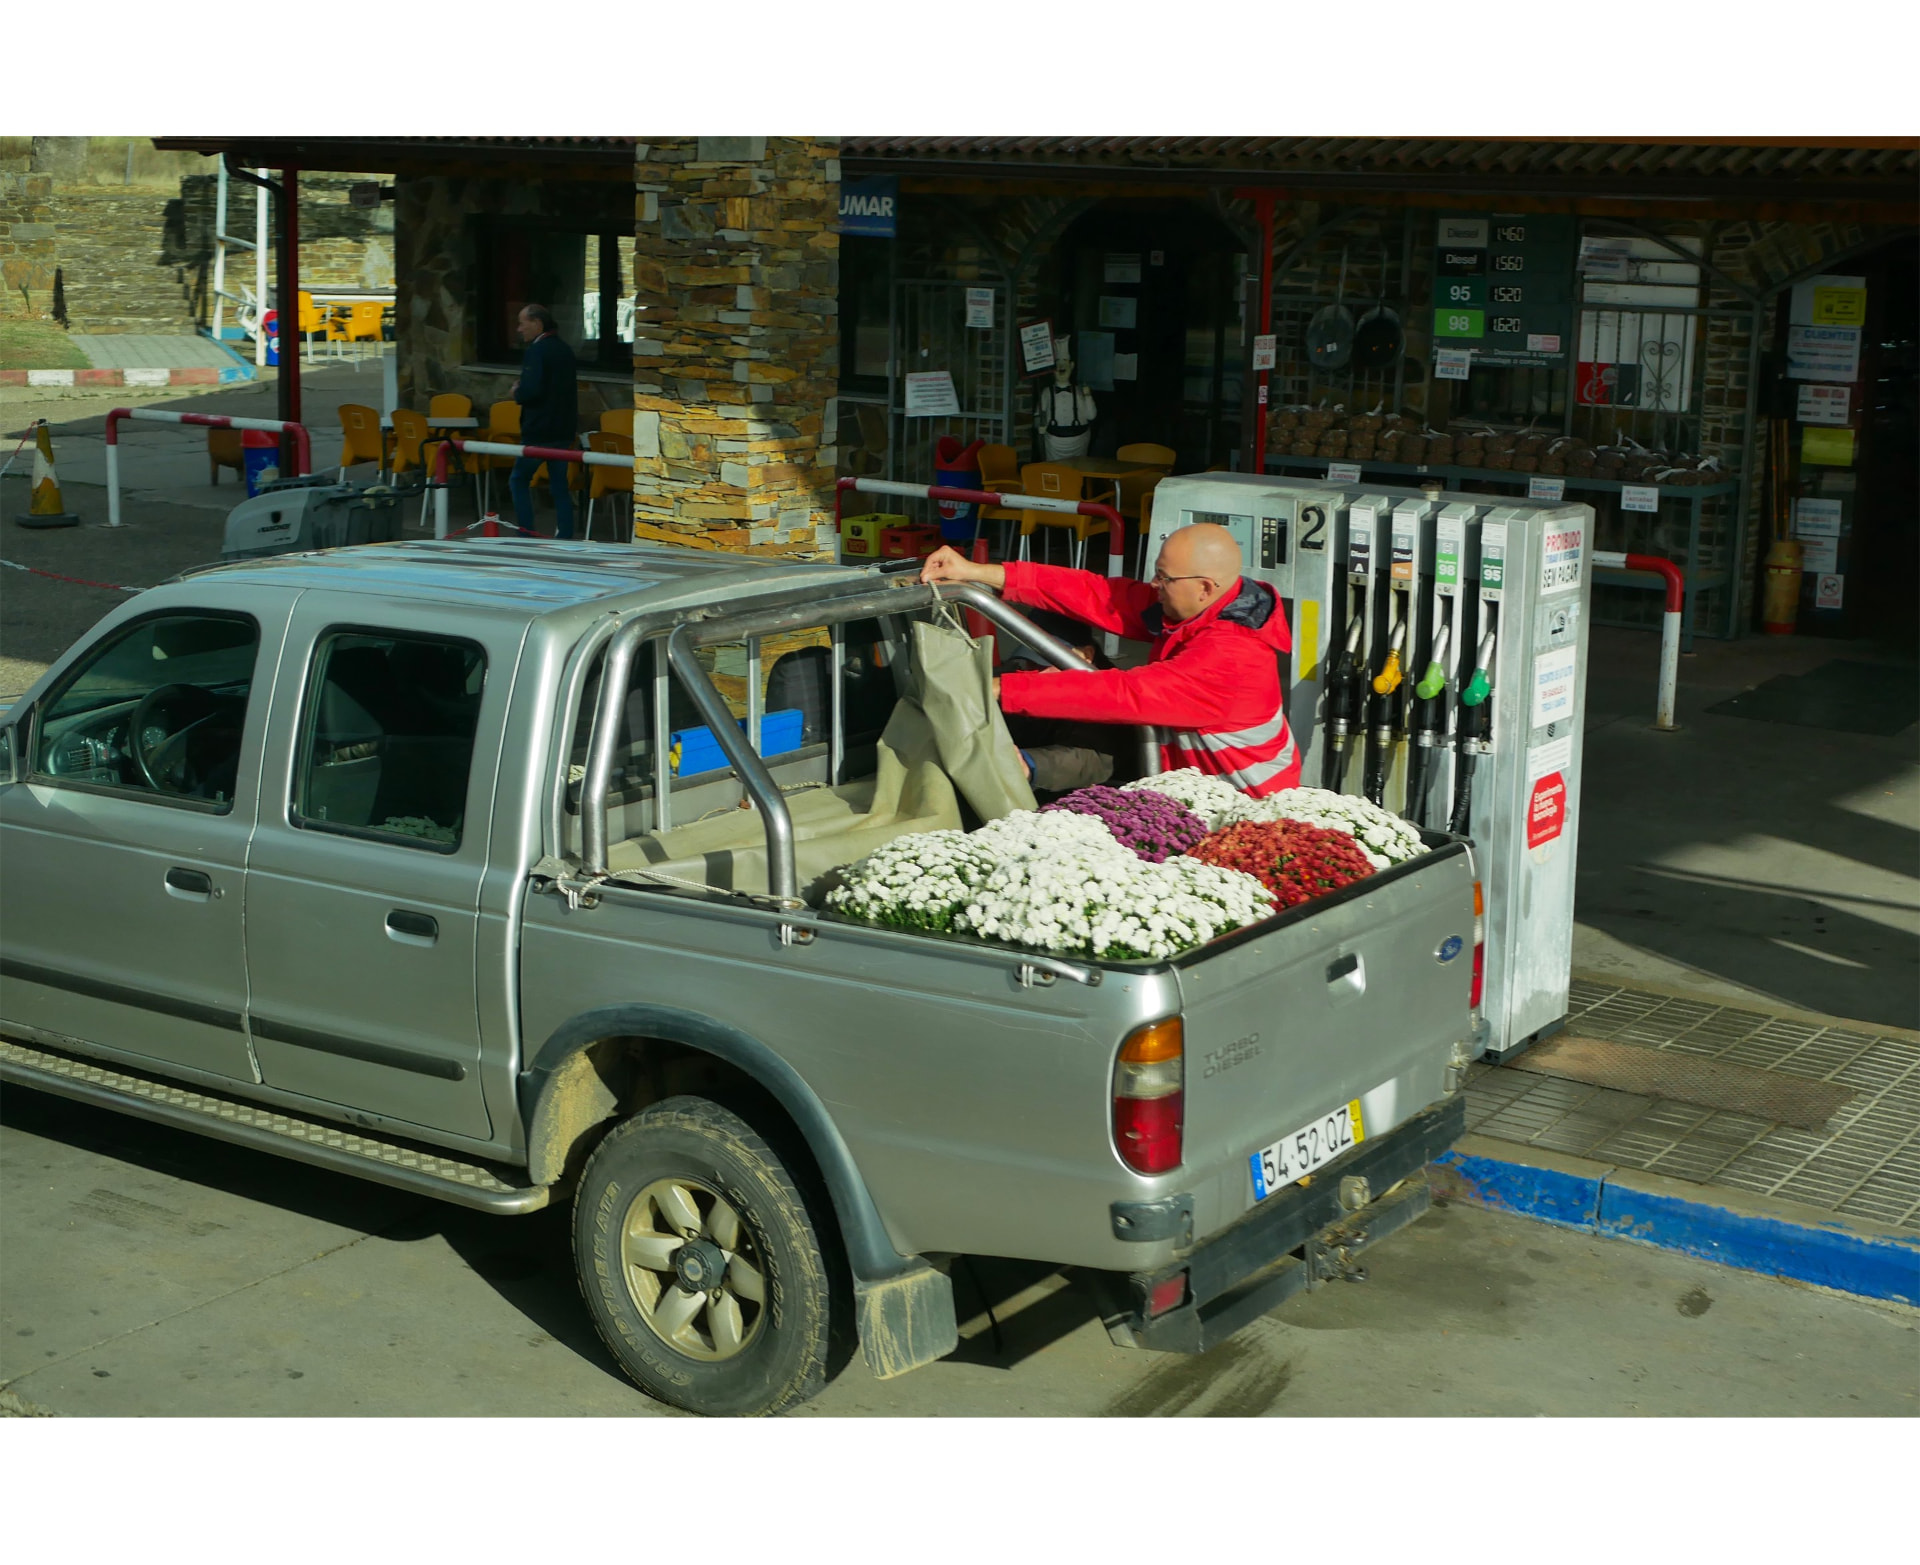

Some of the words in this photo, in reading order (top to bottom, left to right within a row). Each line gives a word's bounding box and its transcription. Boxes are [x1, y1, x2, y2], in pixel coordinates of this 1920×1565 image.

[1445, 254, 1479, 265] Diesel
[1449, 285, 1472, 302] 95
[1449, 315, 1471, 331] 98
[1301, 506, 1326, 550] 2
[1546, 530, 1582, 553] PROIBIDO
[1354, 562, 1365, 573] A
[1438, 563, 1456, 577] 98
[1483, 568, 1502, 582] 95
[1203, 1032, 1259, 1064] TURBO
[1203, 1046, 1263, 1079] DIESEL
